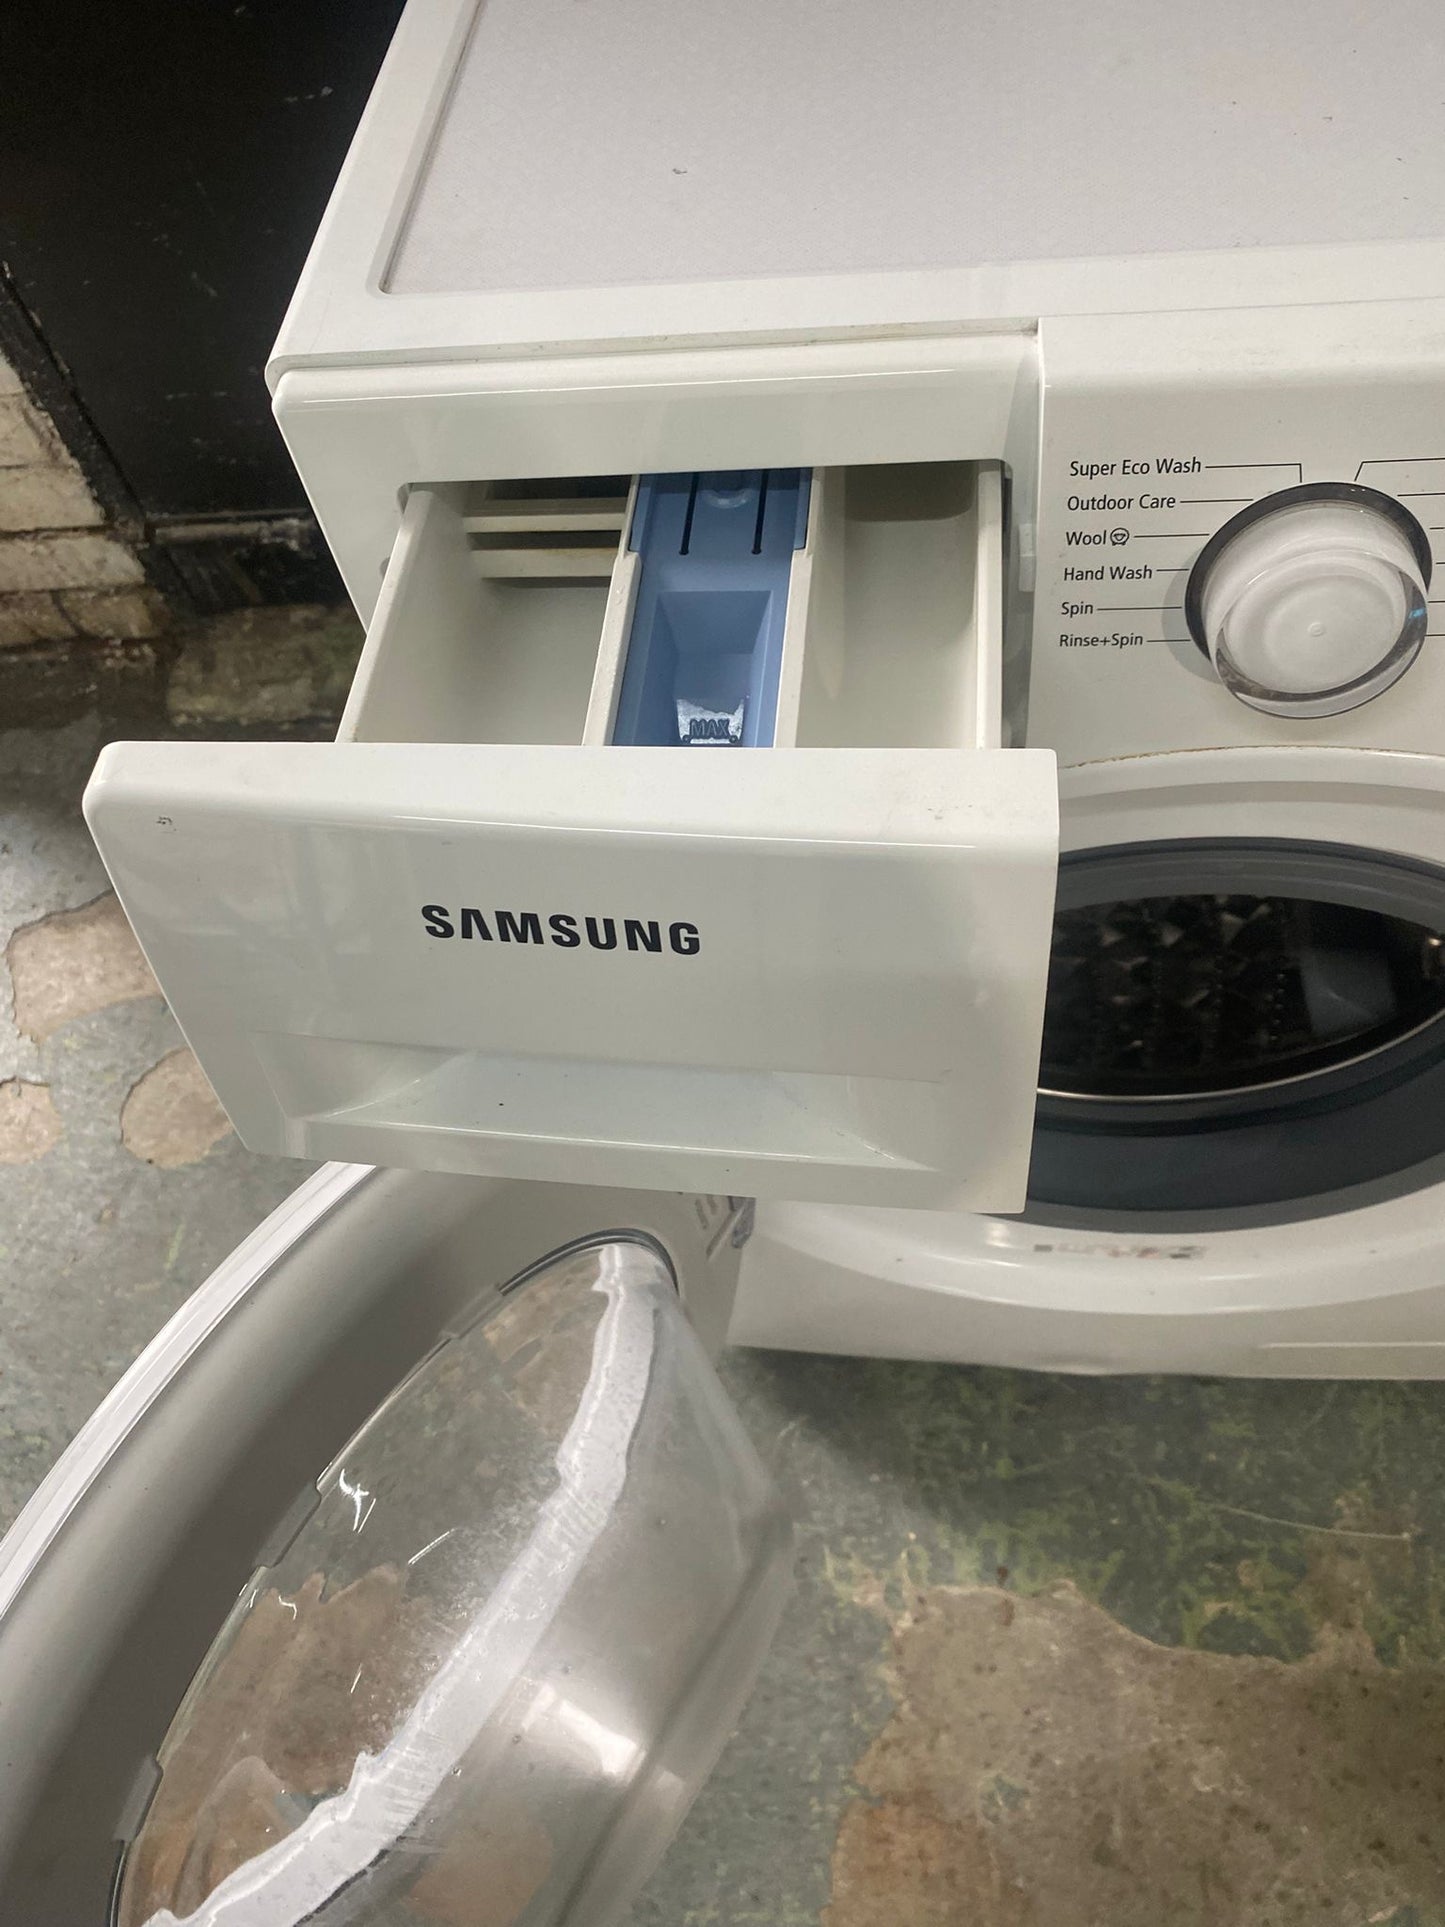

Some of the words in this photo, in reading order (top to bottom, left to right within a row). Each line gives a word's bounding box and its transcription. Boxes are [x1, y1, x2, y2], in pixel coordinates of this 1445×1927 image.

[1069, 460, 1118, 481] Super
[1121, 458, 1151, 476] Eco
[1155, 455, 1202, 475] Wash
[1066, 493, 1135, 512] Outdoor
[1138, 493, 1177, 510] Care
[1065, 529, 1107, 547] Wool
[1063, 565, 1105, 582] Hand
[1109, 564, 1153, 581] Wash
[1060, 600, 1095, 619] Spin
[1059, 632, 1144, 650] Rinse+Spin
[690, 718, 729, 737] MAX
[420, 904, 701, 956] SAMSUNG
